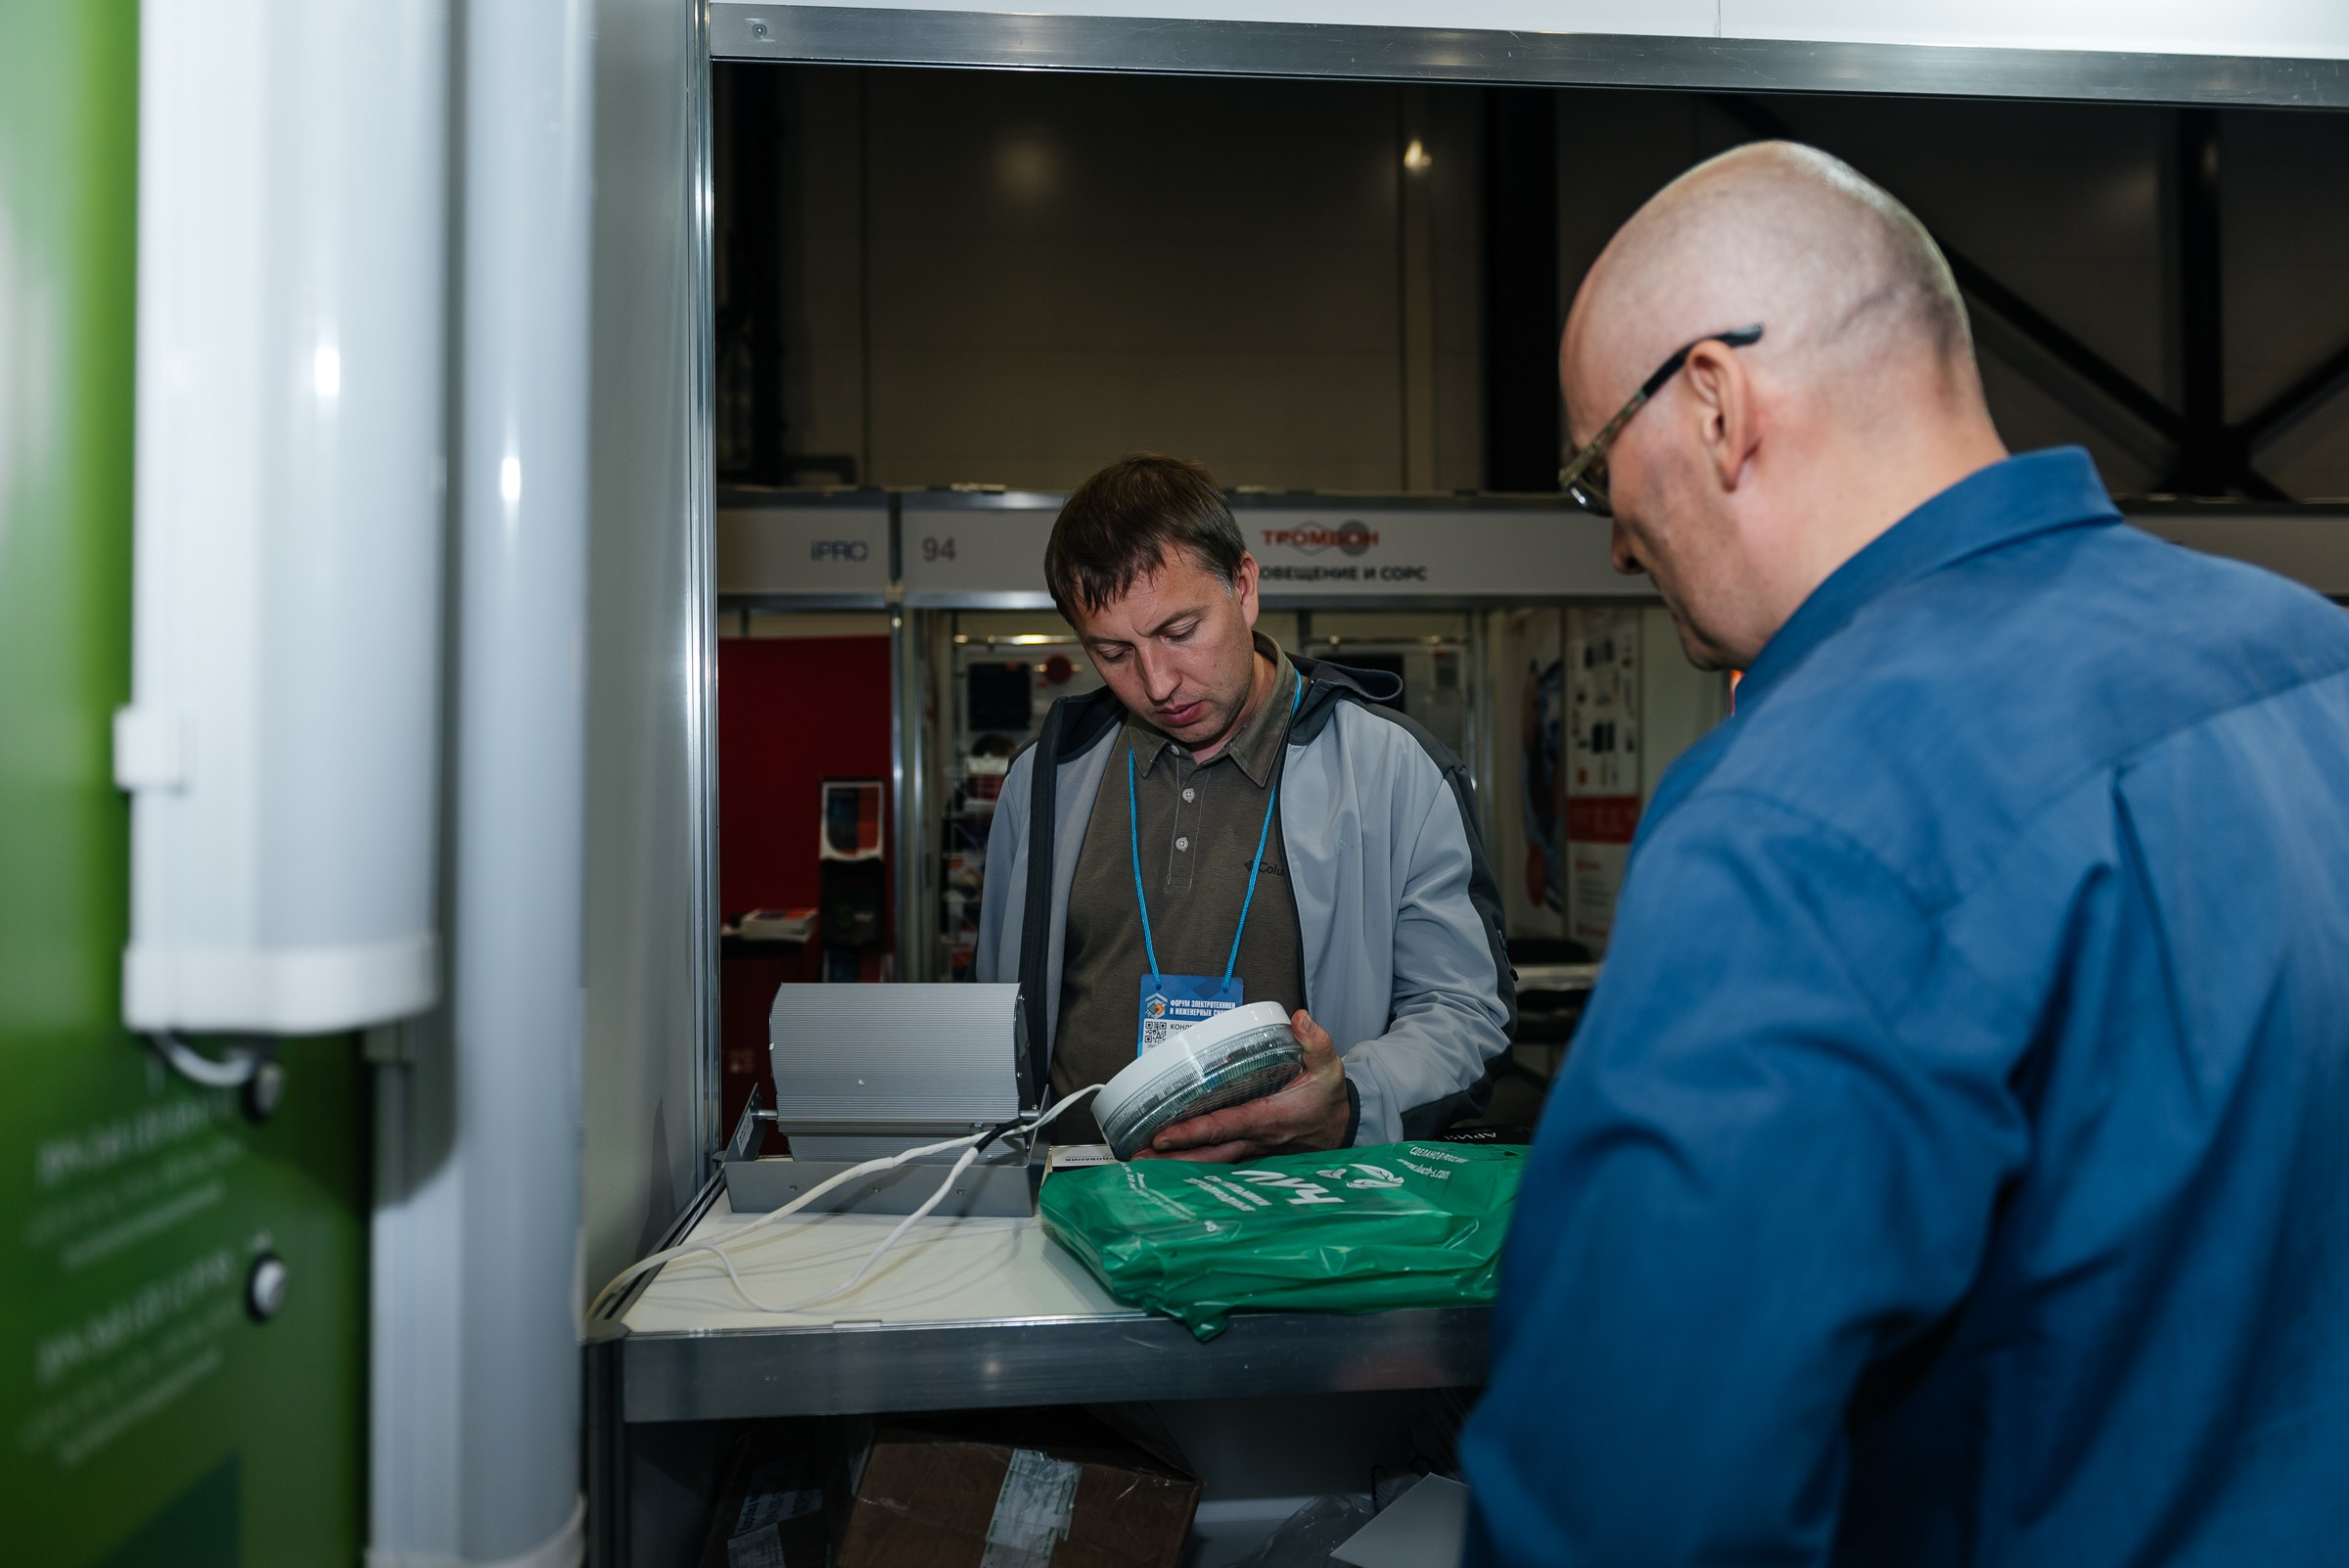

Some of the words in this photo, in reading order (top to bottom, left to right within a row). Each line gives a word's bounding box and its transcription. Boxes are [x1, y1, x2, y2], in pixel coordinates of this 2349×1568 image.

[1262, 529, 1380, 547] ТРОМБОН
[922, 536, 956, 563] 94
[1259, 566, 1359, 582] ОВЕЩЕНИЕ
[1363, 566, 1376, 581] И
[1380, 566, 1428, 581] СОРС
[1259, 861, 1284, 876] Colu
[1170, 999, 1191, 1008] ФОРУМ
[1191, 1000, 1236, 1009] ЭЛЕКТРОТЕХНИКИ
[1175, 1008, 1212, 1017] ИНЖЕНЕРНЫХ
[1409, 1146, 1441, 1161] СДЕЛАНО
